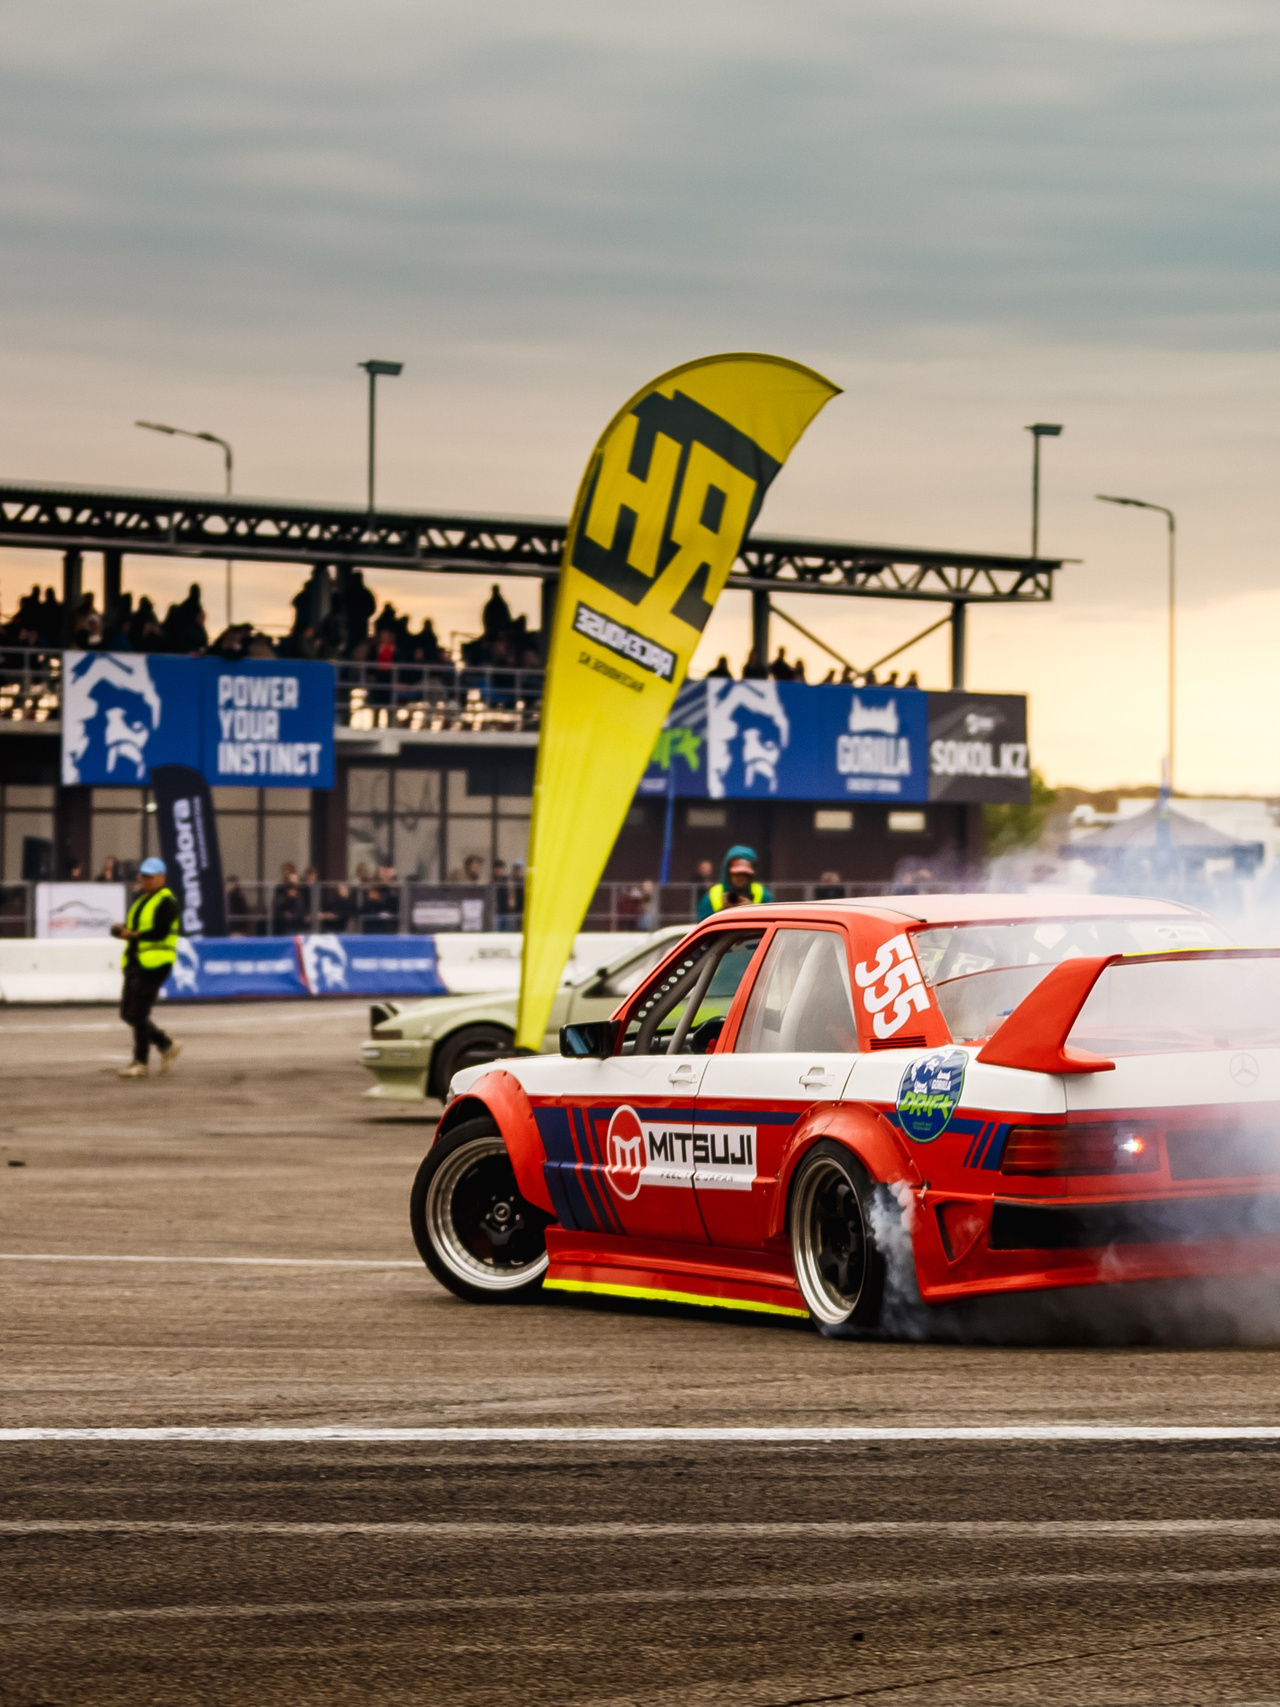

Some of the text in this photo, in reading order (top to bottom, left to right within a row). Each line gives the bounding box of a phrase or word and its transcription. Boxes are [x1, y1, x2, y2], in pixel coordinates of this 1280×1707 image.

[218, 675, 299, 709] POWER
[218, 709, 279, 741] YOUR
[218, 742, 322, 776] INSTINCT
[837, 735, 911, 775] GORILLA
[931, 739, 1029, 778] SOKOL.KZ
[173, 798, 204, 932] Pandora
[855, 933, 930, 1039] 555
[899, 1090, 953, 1120] DRIFT
[648, 1131, 752, 1165] MITSUJI
[685, 1172, 701, 1181] TE
